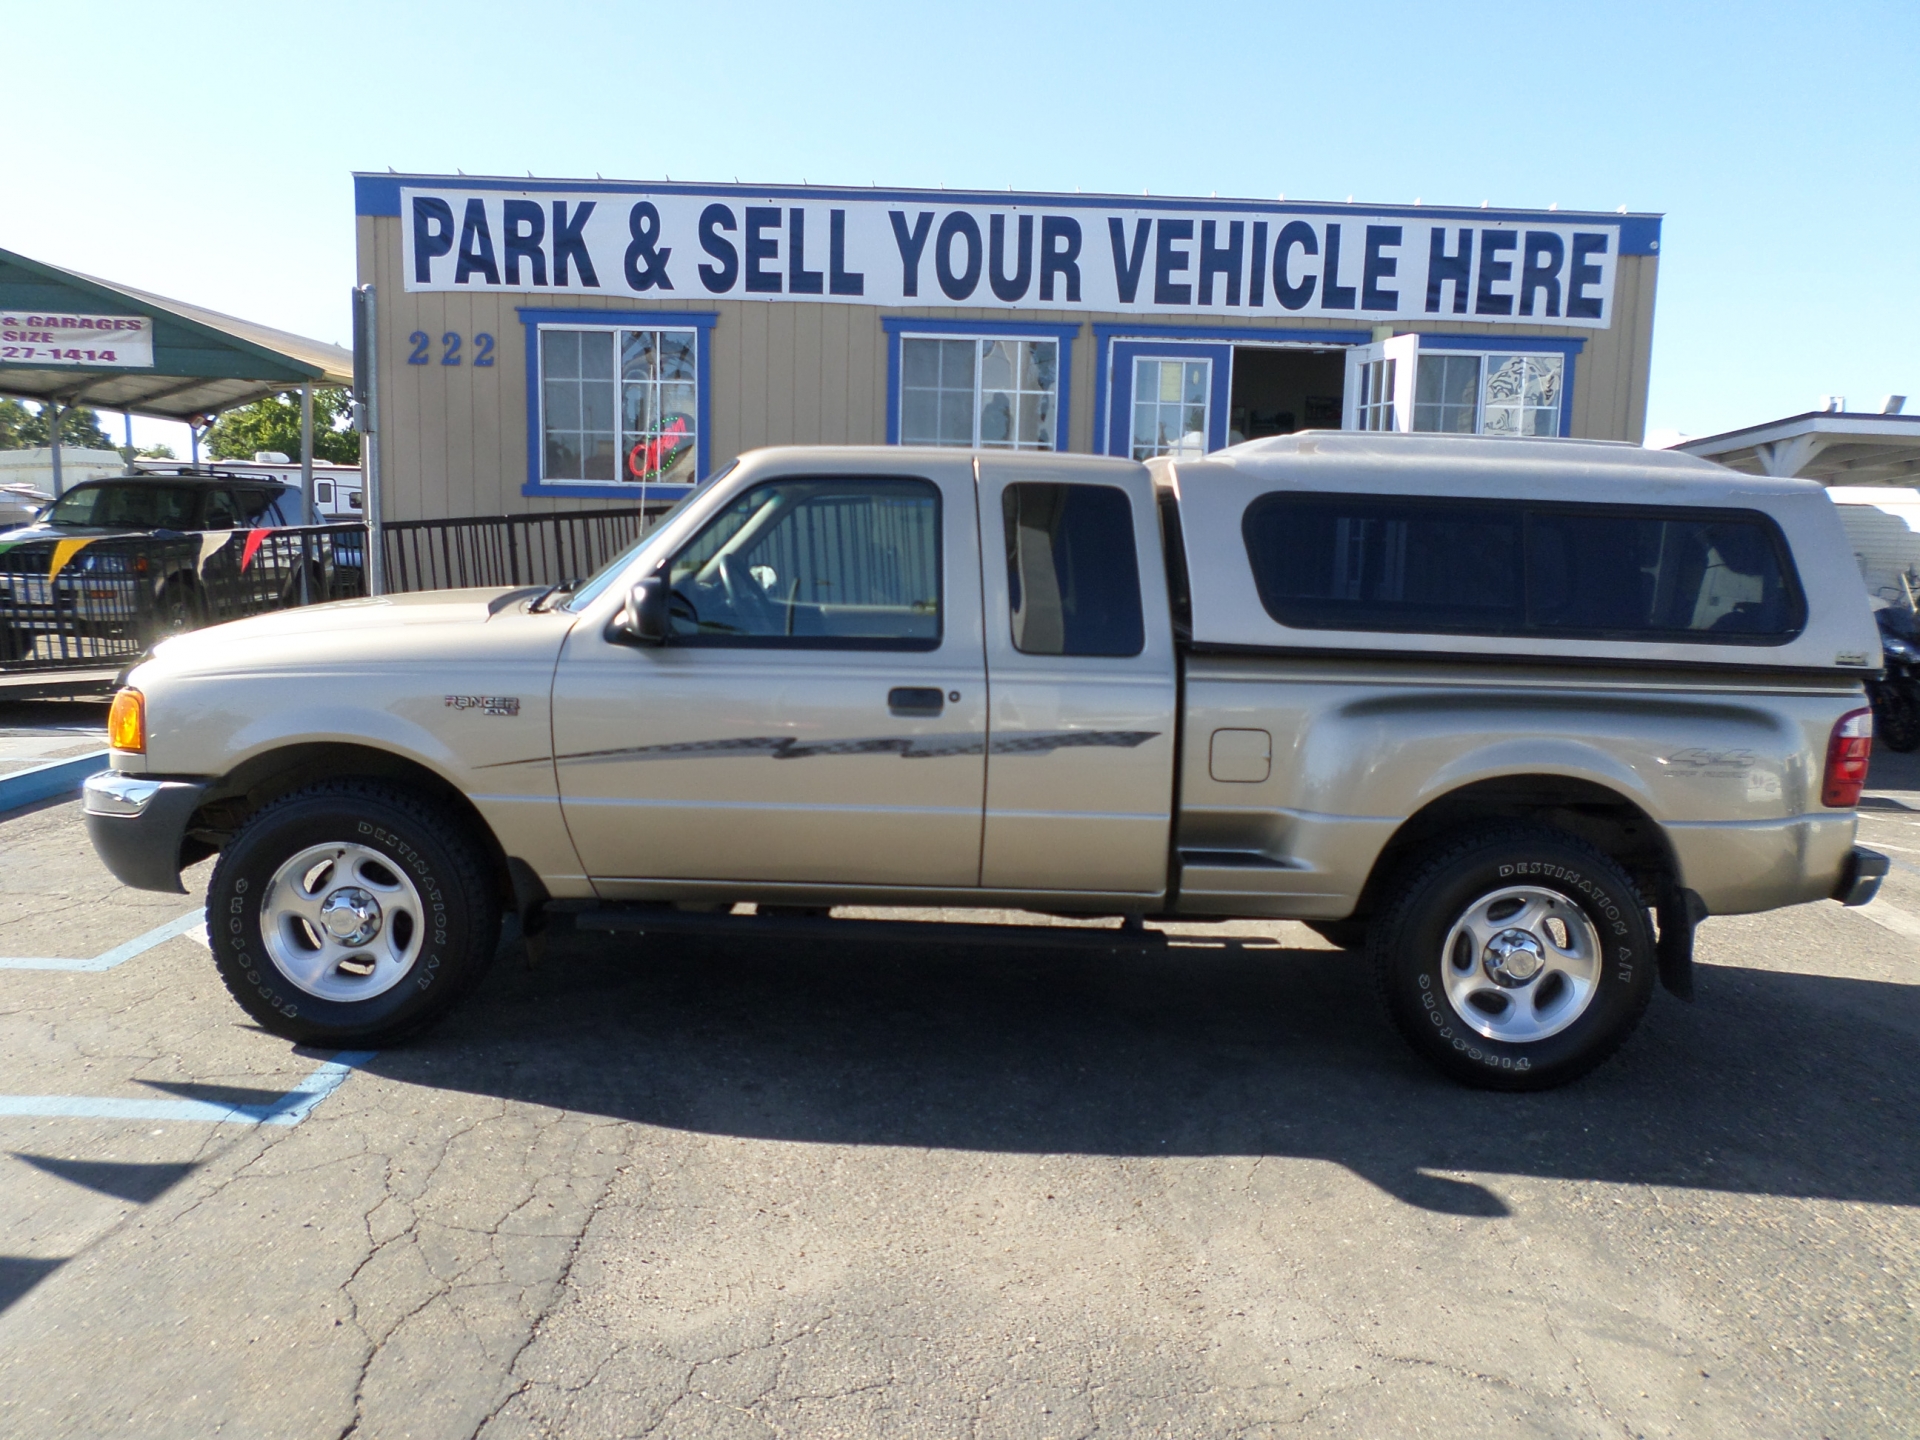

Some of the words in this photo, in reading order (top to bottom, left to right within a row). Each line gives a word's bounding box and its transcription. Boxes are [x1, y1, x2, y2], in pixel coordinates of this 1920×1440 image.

[412, 196, 600, 288] PARK
[624, 200, 674, 292] &
[697, 202, 864, 296] SELL
[889, 208, 1082, 303] YOUR
[1108, 216, 1403, 312] VEHICLE
[1425, 226, 1609, 319] HERE
[2, 317, 19, 327] &
[27, 316, 142, 330] GARAGES
[2, 331, 54, 343] SIZE
[407, 331, 495, 367] 222
[358, 821, 448, 945] DESTINATION
[1499, 862, 1627, 936] DESTINATION
